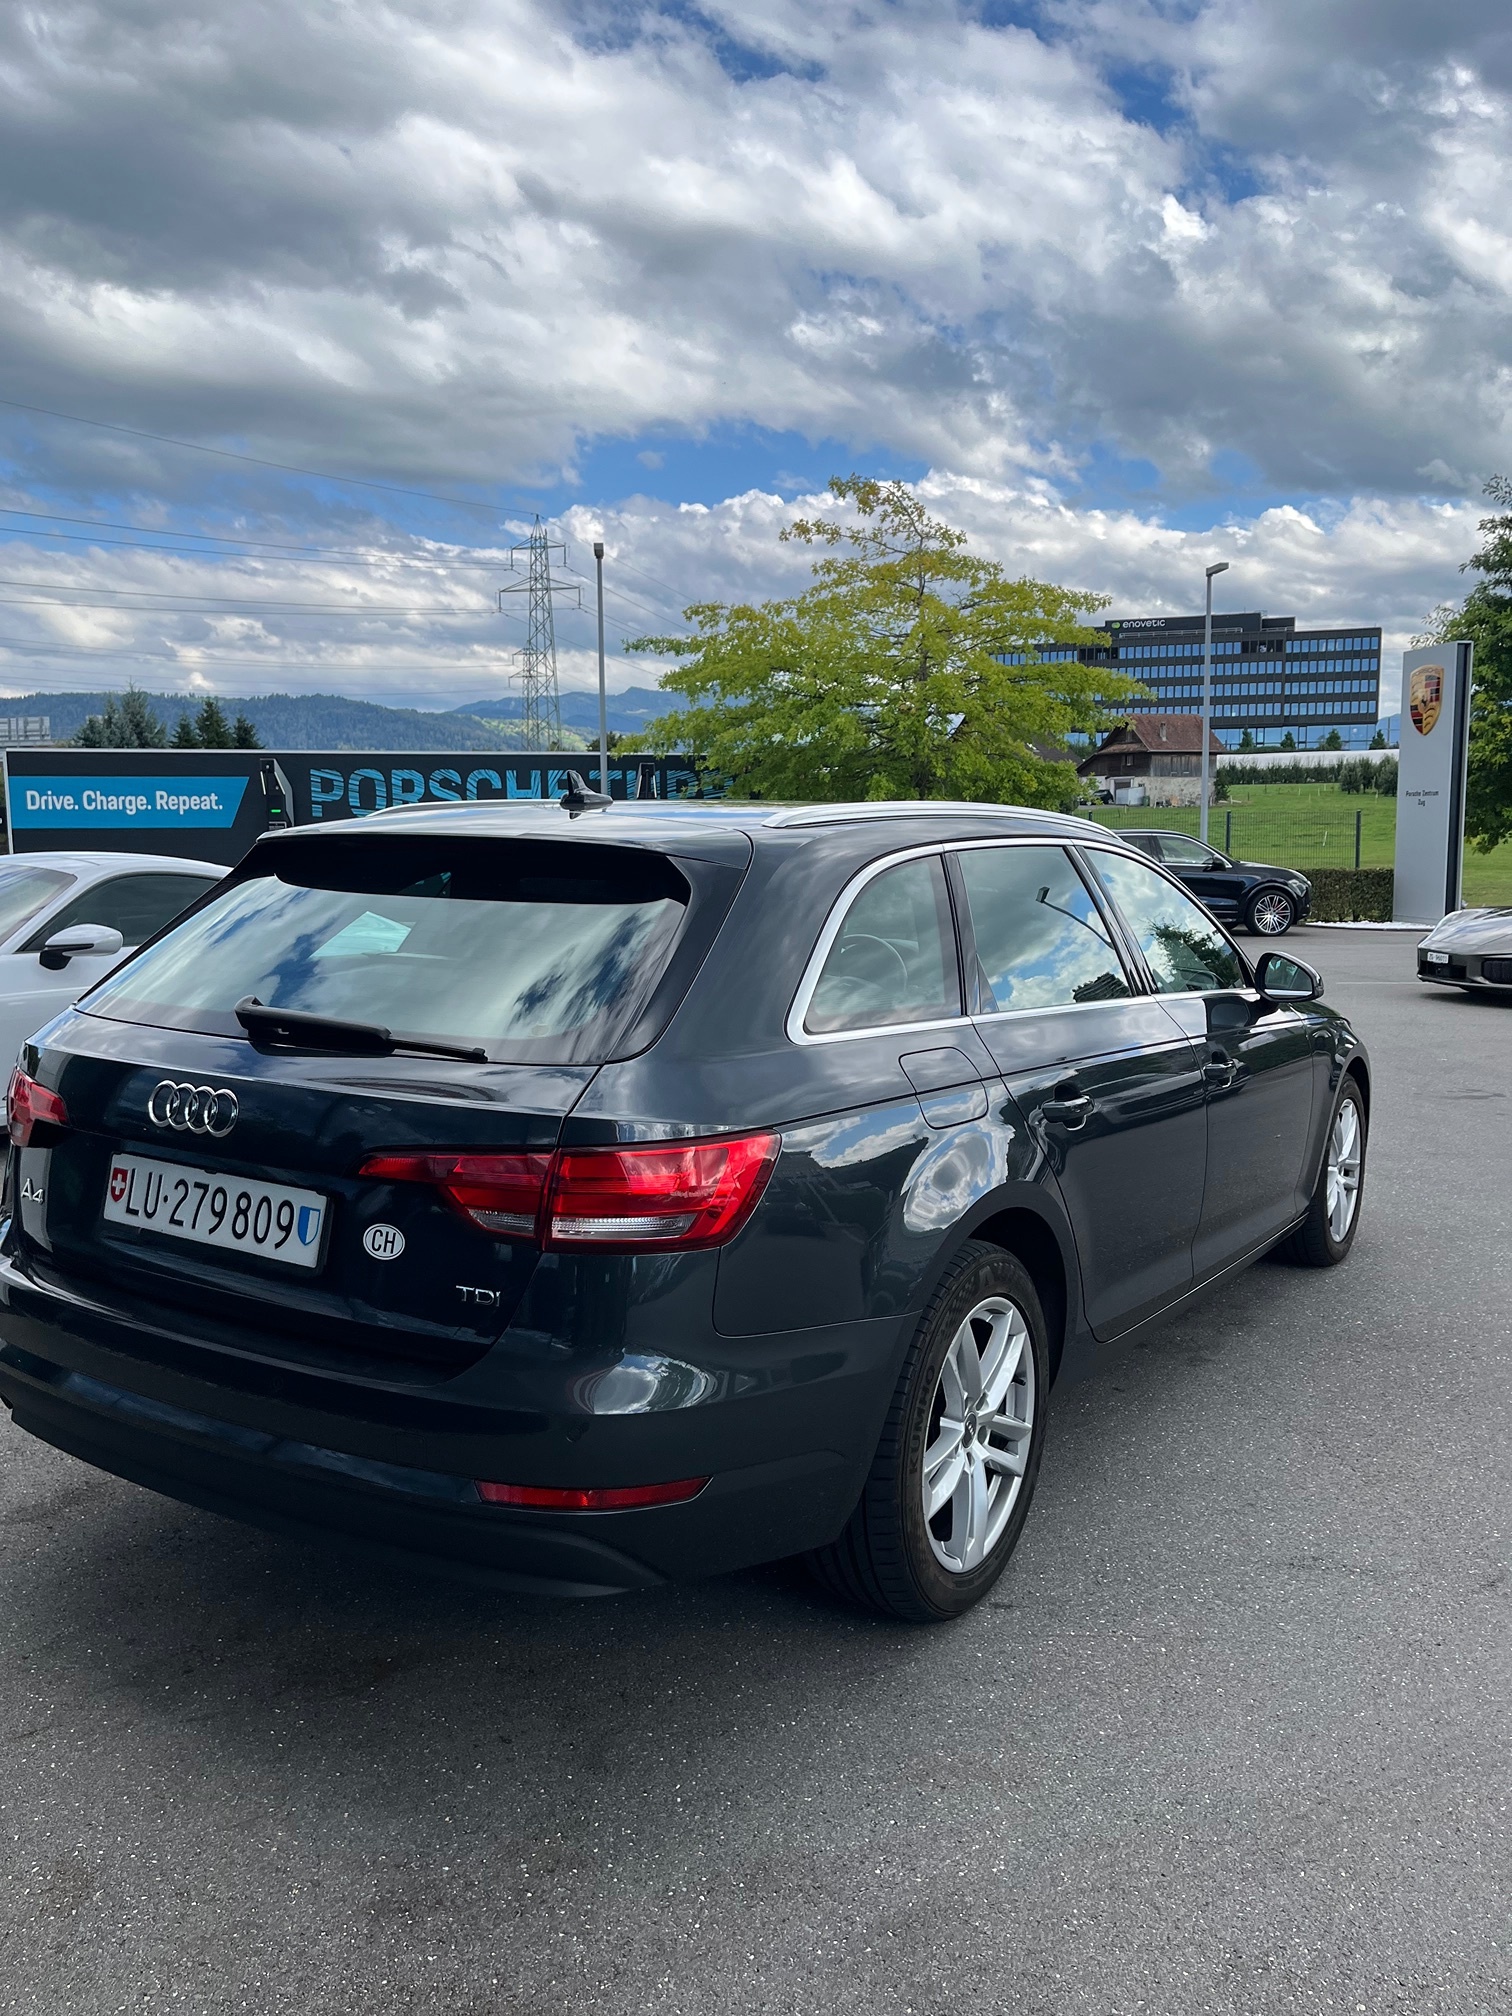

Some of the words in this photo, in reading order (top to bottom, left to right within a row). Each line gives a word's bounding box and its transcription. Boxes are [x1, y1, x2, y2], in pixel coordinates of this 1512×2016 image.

[1122, 619, 1166, 629] enovetic
[26, 790, 79, 811] Drive.
[82, 790, 152, 815] Charge.
[155, 790, 223, 815] Repeat.
[20, 1177, 45, 1205] A4
[369, 1226, 399, 1255] CH
[454, 1284, 502, 1307] TDI
[908, 1364, 936, 1475] KUMHO
